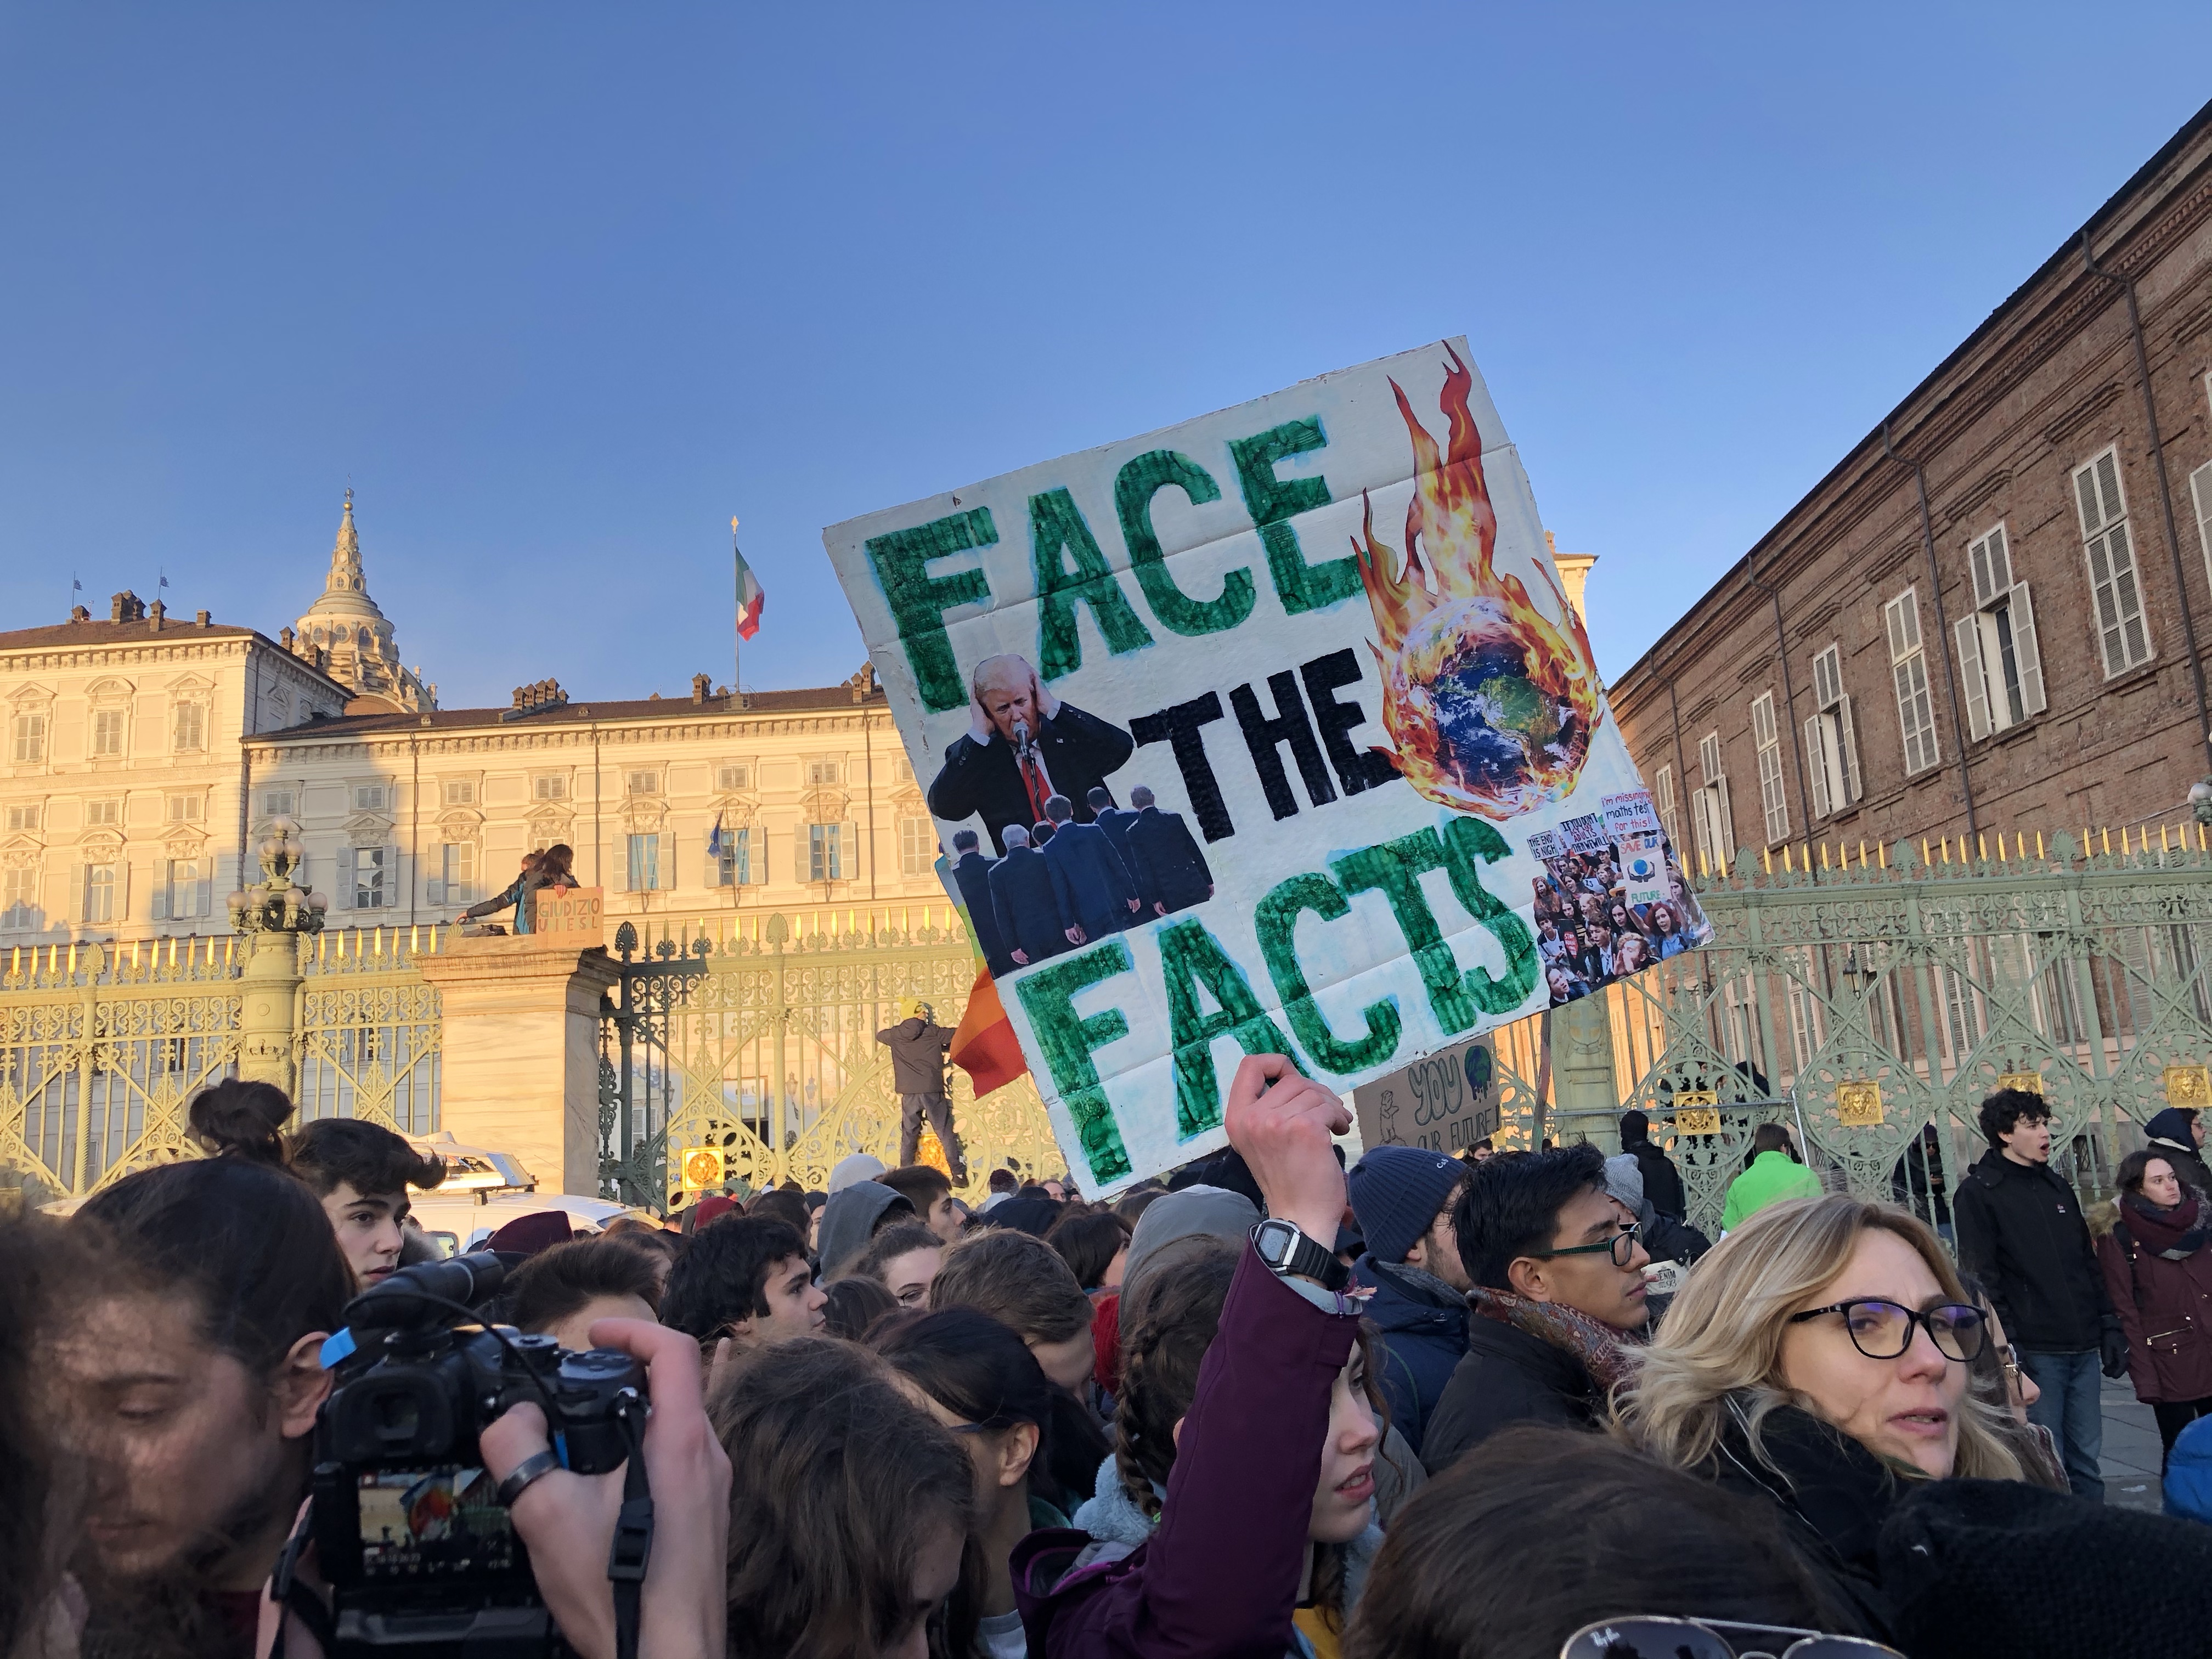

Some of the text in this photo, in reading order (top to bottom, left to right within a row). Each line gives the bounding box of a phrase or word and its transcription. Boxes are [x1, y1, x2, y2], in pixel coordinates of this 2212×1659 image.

[865, 414, 1373, 713] FACE
[1128, 647, 1403, 844] THE
[1606, 802, 1650, 820] maths test
[1559, 820, 1572, 832] IF
[1615, 822, 1628, 833] for
[1528, 834, 1553, 848] THE END
[1573, 829, 1597, 843] ADULTS
[1533, 844, 1557, 859] IS NIGH
[1621, 836, 1659, 854] SAVE OUR
[1631, 890, 1661, 904] FUTURE
[538, 898, 600, 918] GIUDIZIO
[1015, 815, 1541, 1187] FACTS
[1408, 1054, 1463, 1126] YOU
[1658, 1270, 1677, 1281] ENIM
